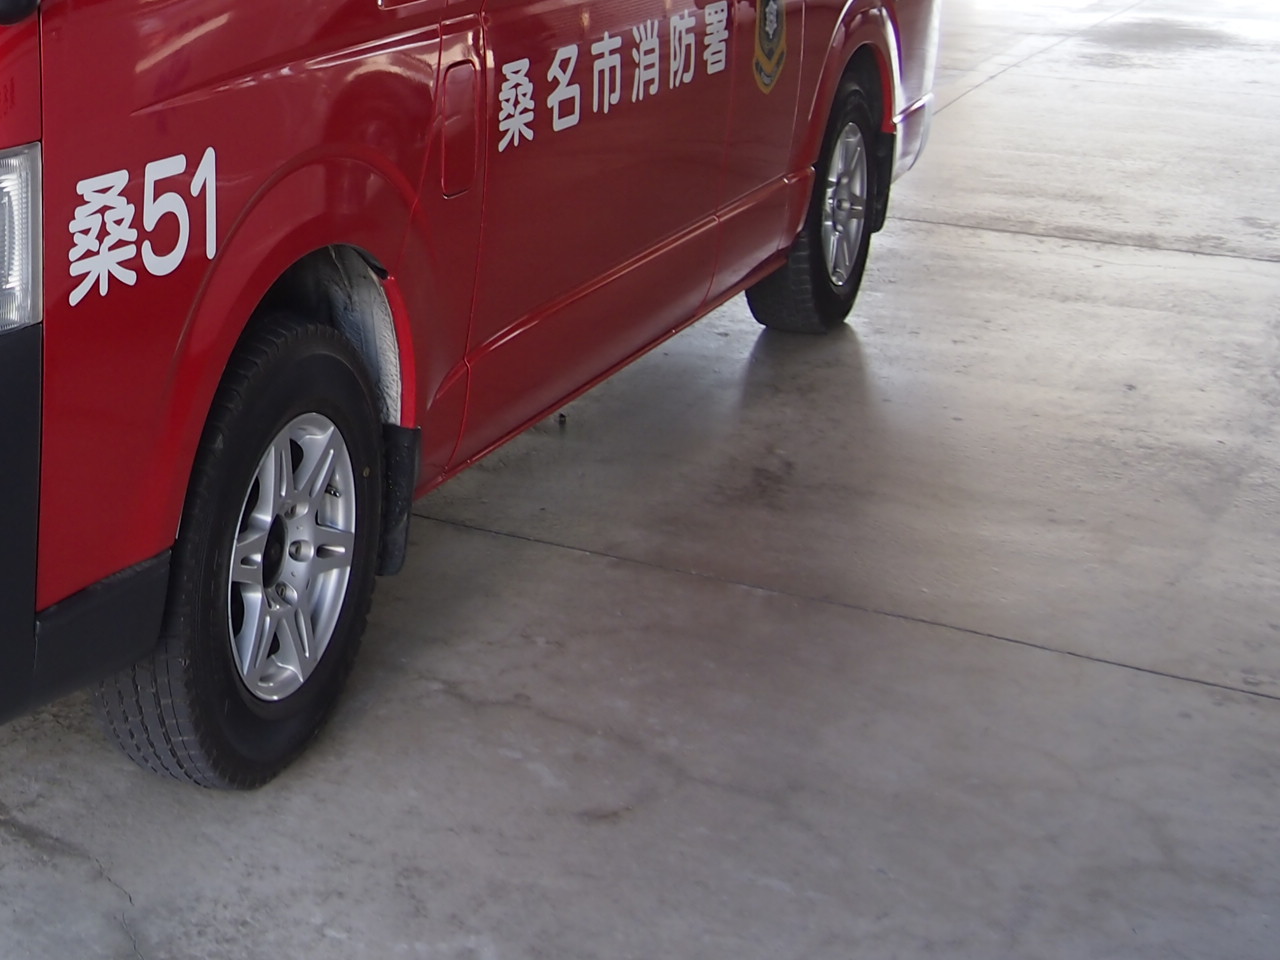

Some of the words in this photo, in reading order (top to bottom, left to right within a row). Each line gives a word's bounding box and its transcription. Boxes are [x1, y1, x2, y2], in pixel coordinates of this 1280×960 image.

[498, 0, 729, 152] 桑名市消防署
[69, 146, 216, 307] 桑51
